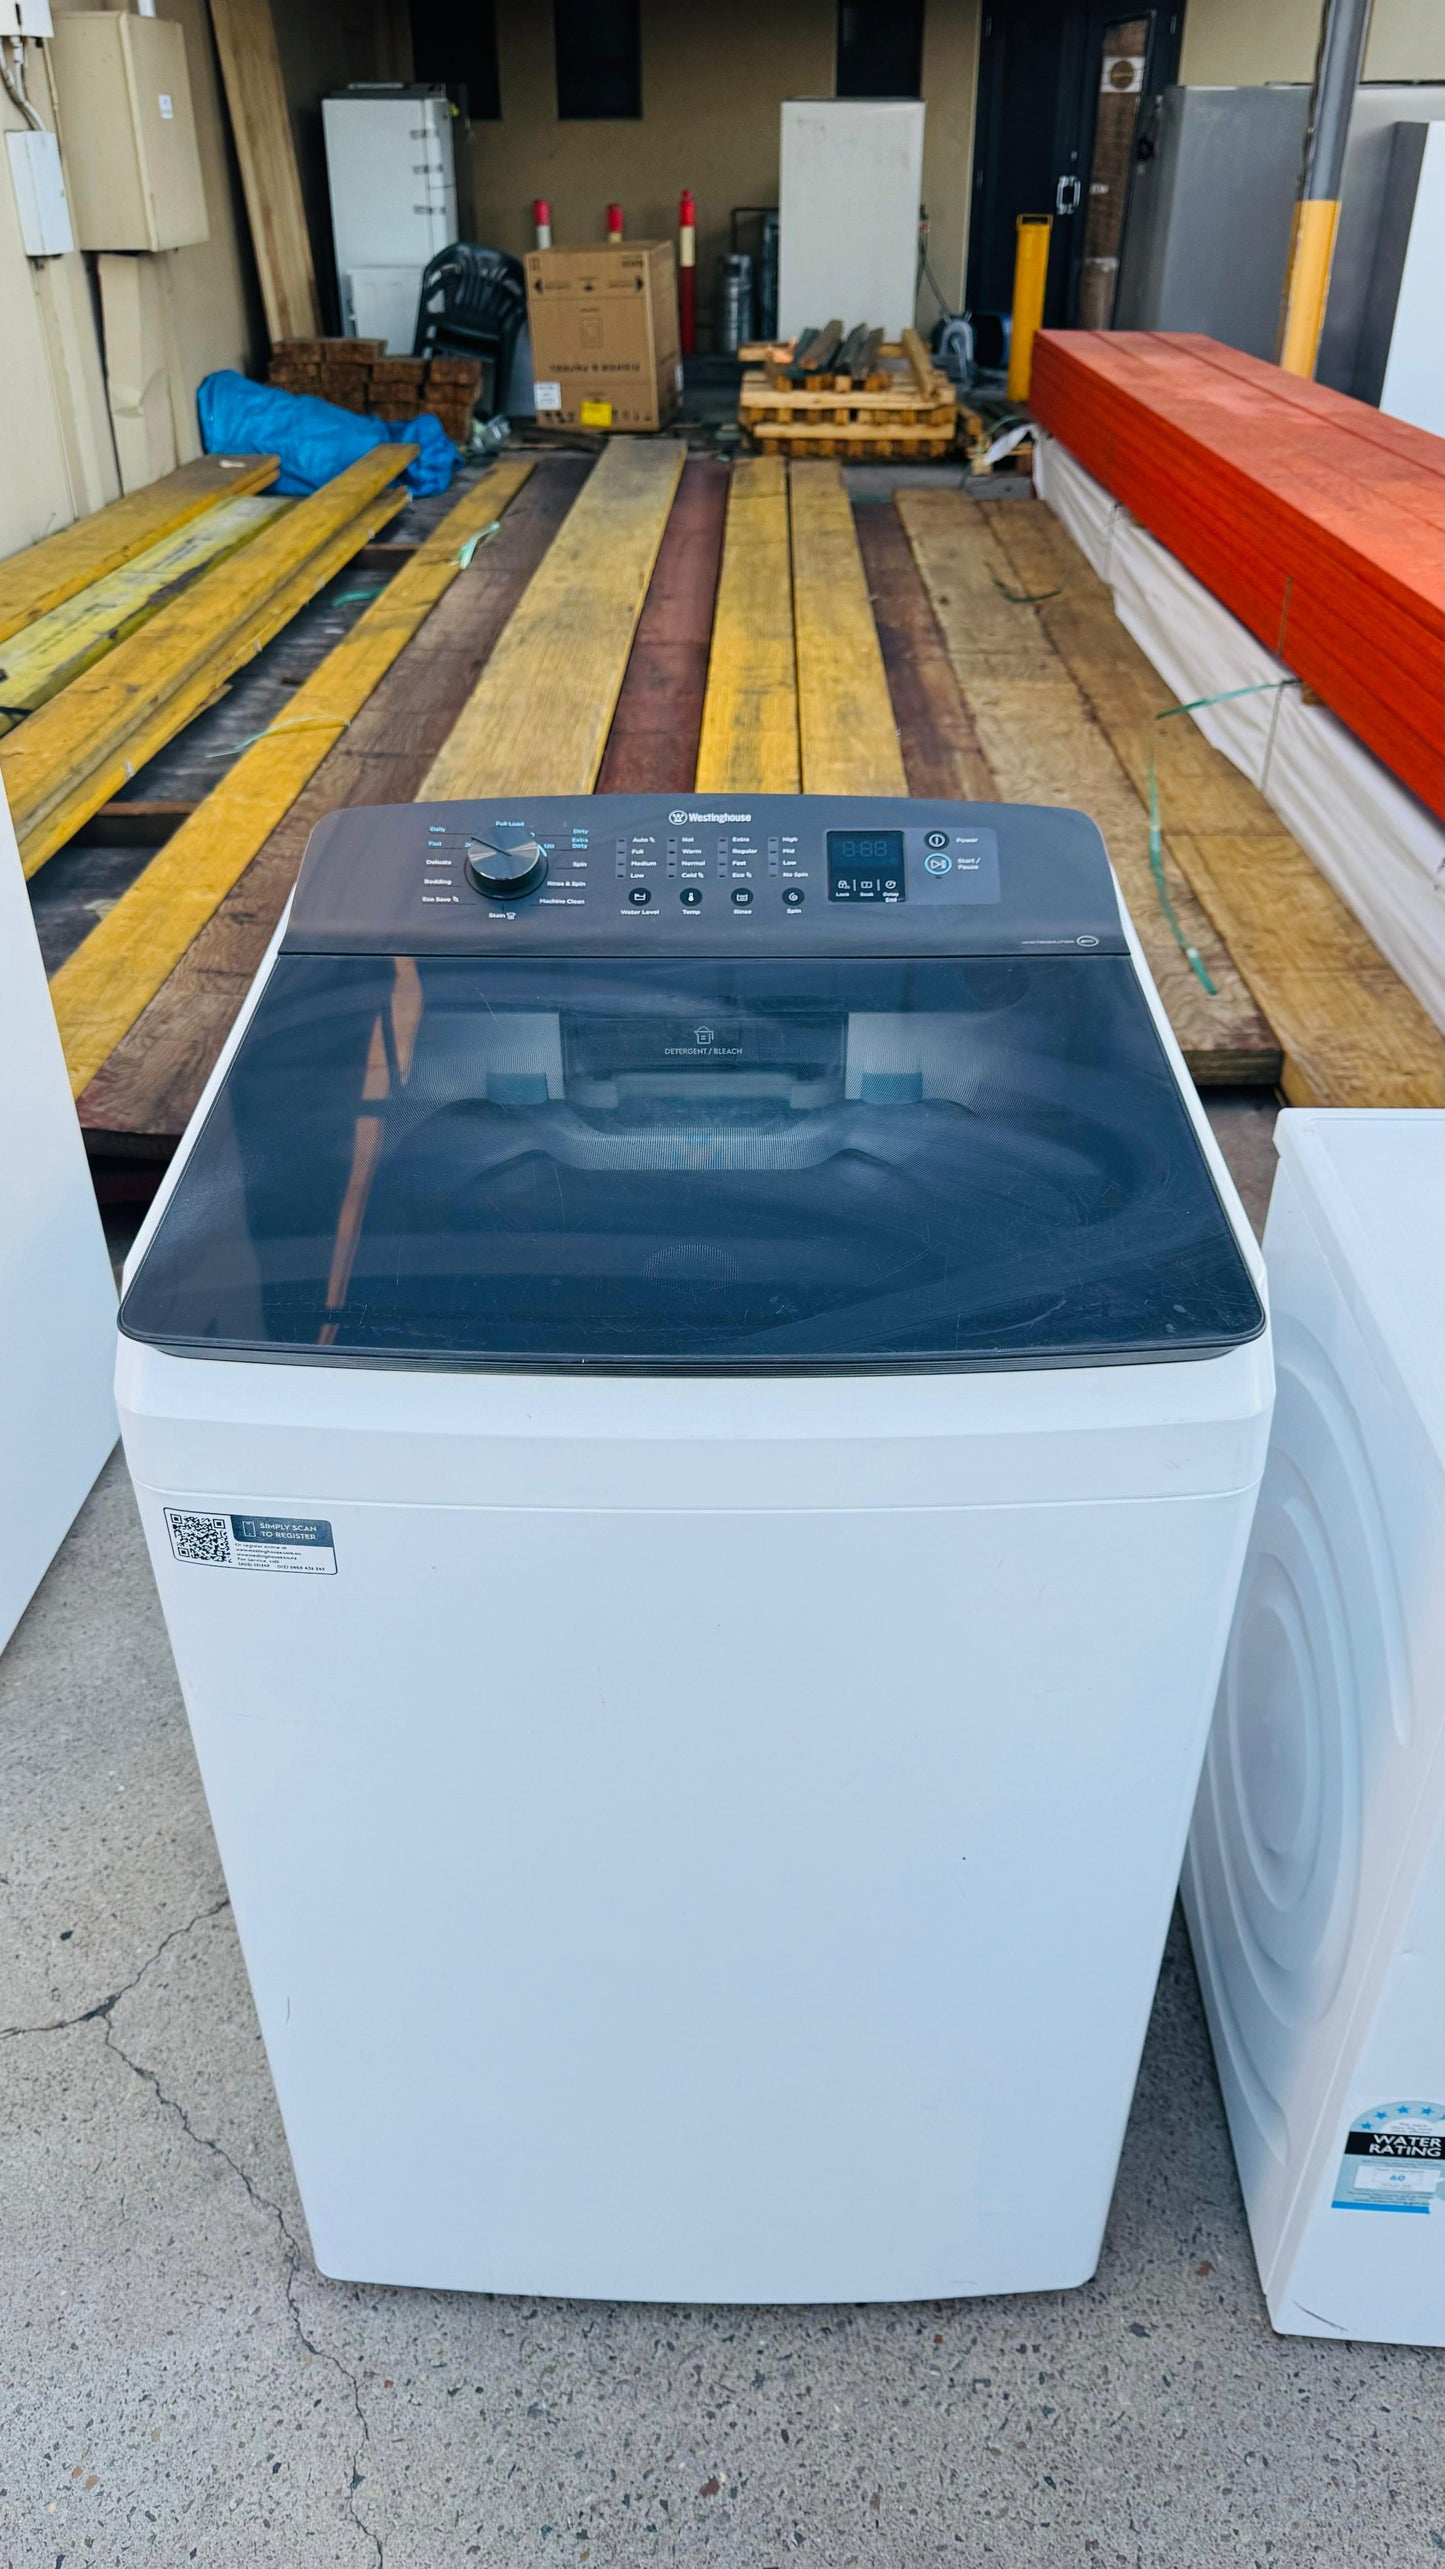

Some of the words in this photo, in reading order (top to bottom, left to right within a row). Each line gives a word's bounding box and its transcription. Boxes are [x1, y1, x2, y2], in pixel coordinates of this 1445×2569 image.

[688, 812, 752, 824] Westinghouse
[260, 1522, 290, 1531] SIMPLY
[275, 1532, 316, 1540] REGISTER
[1374, 2134, 1442, 2148] WATER
[1369, 2144, 1442, 2157] RATING
